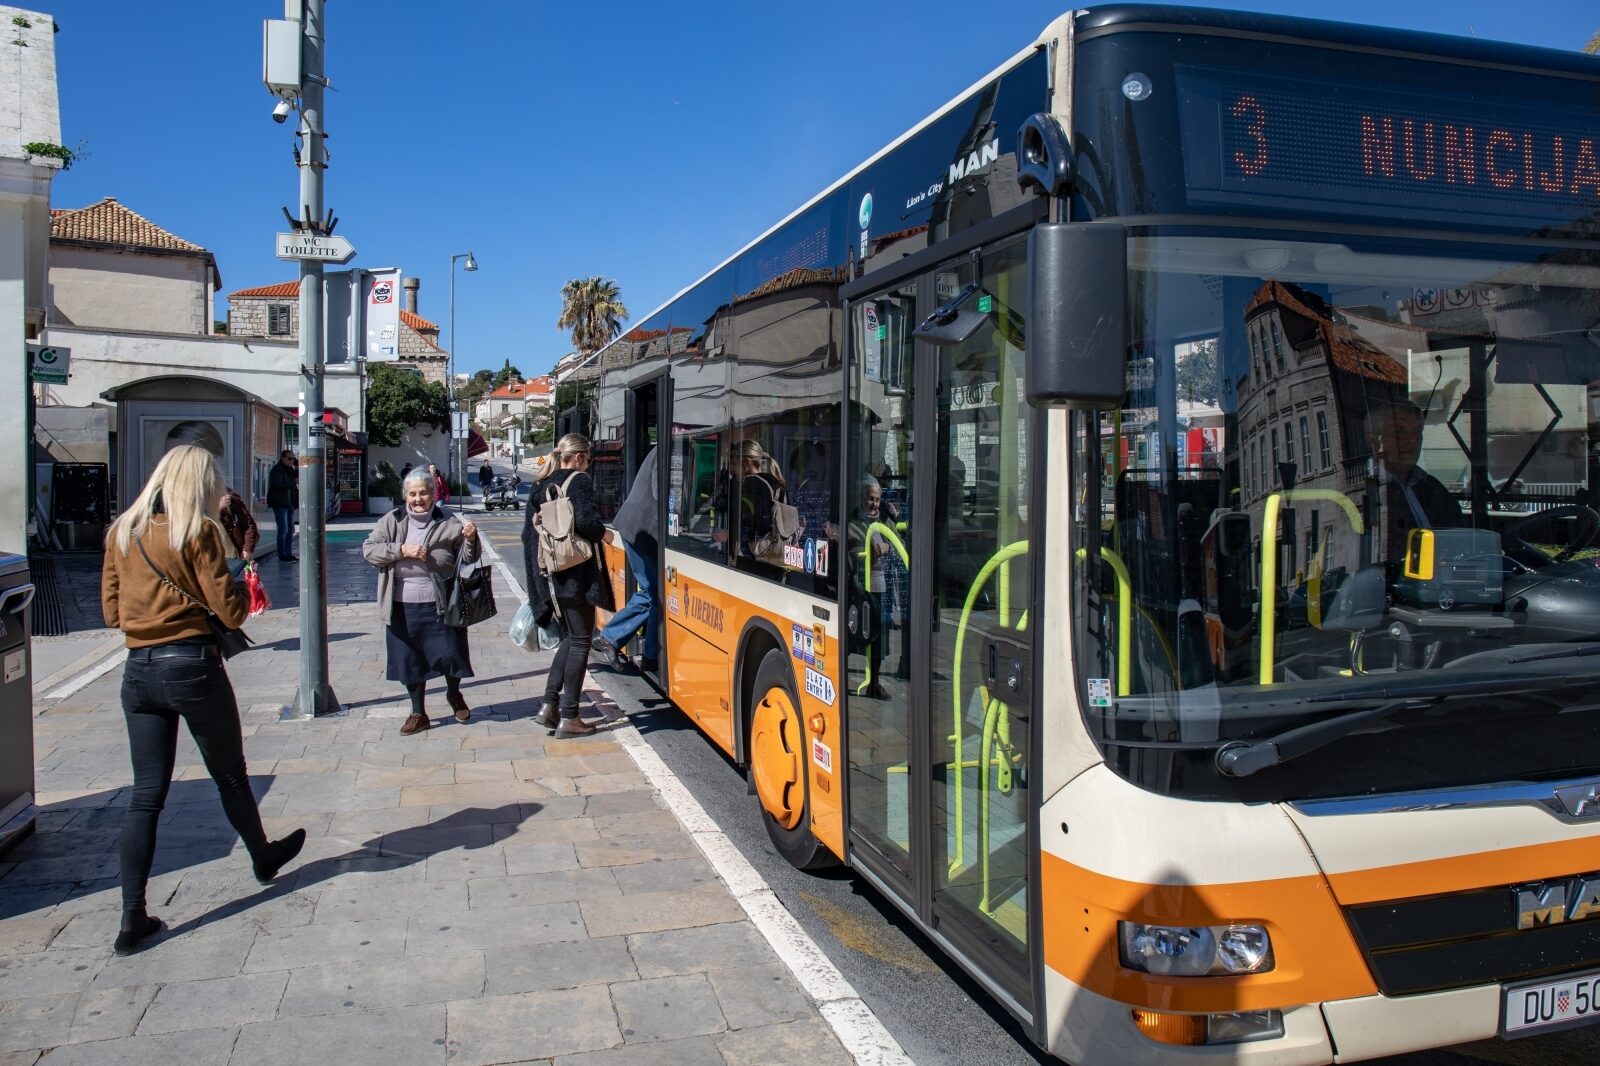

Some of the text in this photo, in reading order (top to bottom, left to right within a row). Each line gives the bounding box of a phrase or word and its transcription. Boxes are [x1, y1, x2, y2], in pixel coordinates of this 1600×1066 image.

[1233, 97, 1267, 175] 3
[948, 138, 999, 185] MAN
[906, 182, 944, 208] Lion's City
[283, 246, 338, 256] TOILETTE
[303, 237, 321, 247] WC
[691, 595, 724, 634] LIBERTAS
[806, 681, 823, 699] ENTRY
[1524, 988, 1555, 1024] DU
